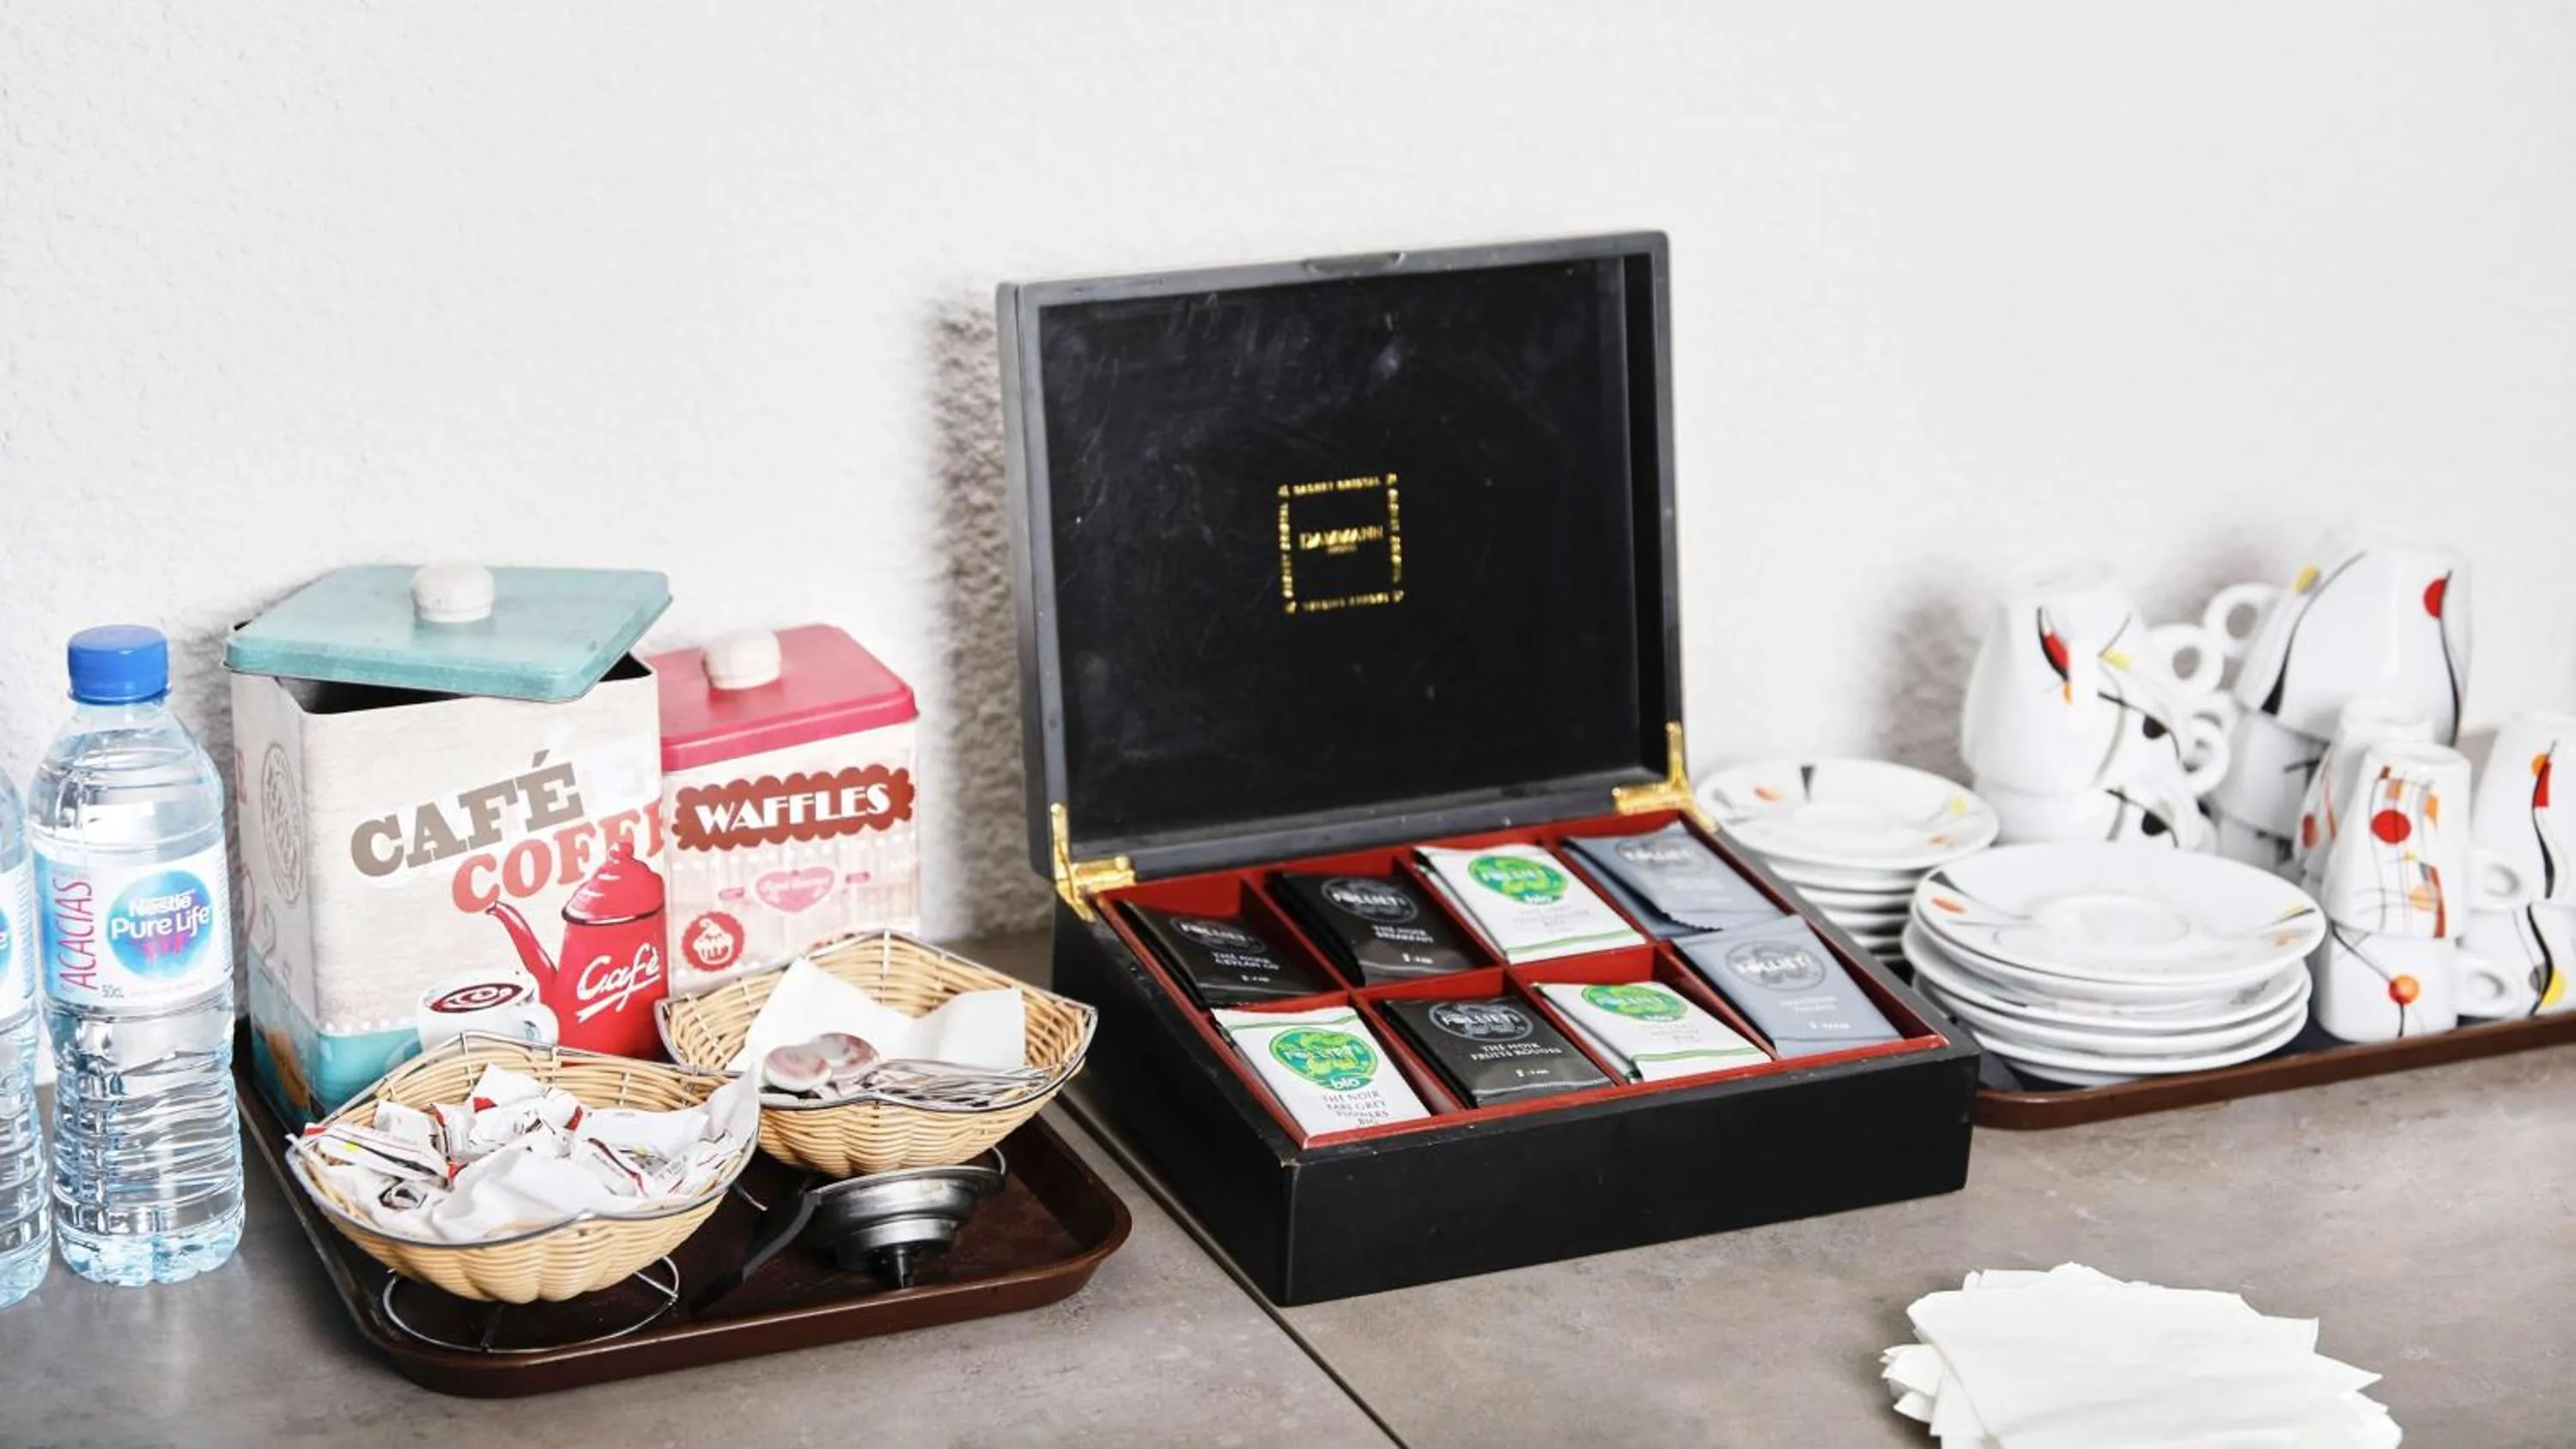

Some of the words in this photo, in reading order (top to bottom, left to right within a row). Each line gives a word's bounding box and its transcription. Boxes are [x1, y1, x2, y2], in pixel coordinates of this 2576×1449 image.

[350, 749, 585, 877] CAFÉ
[695, 782, 891, 835] WAFFLES
[52, 877, 97, 991] ACACIAS
[111, 917, 173, 940] Pure
[175, 906, 211, 938] Life
[1331, 1077, 1360, 1090] bio
